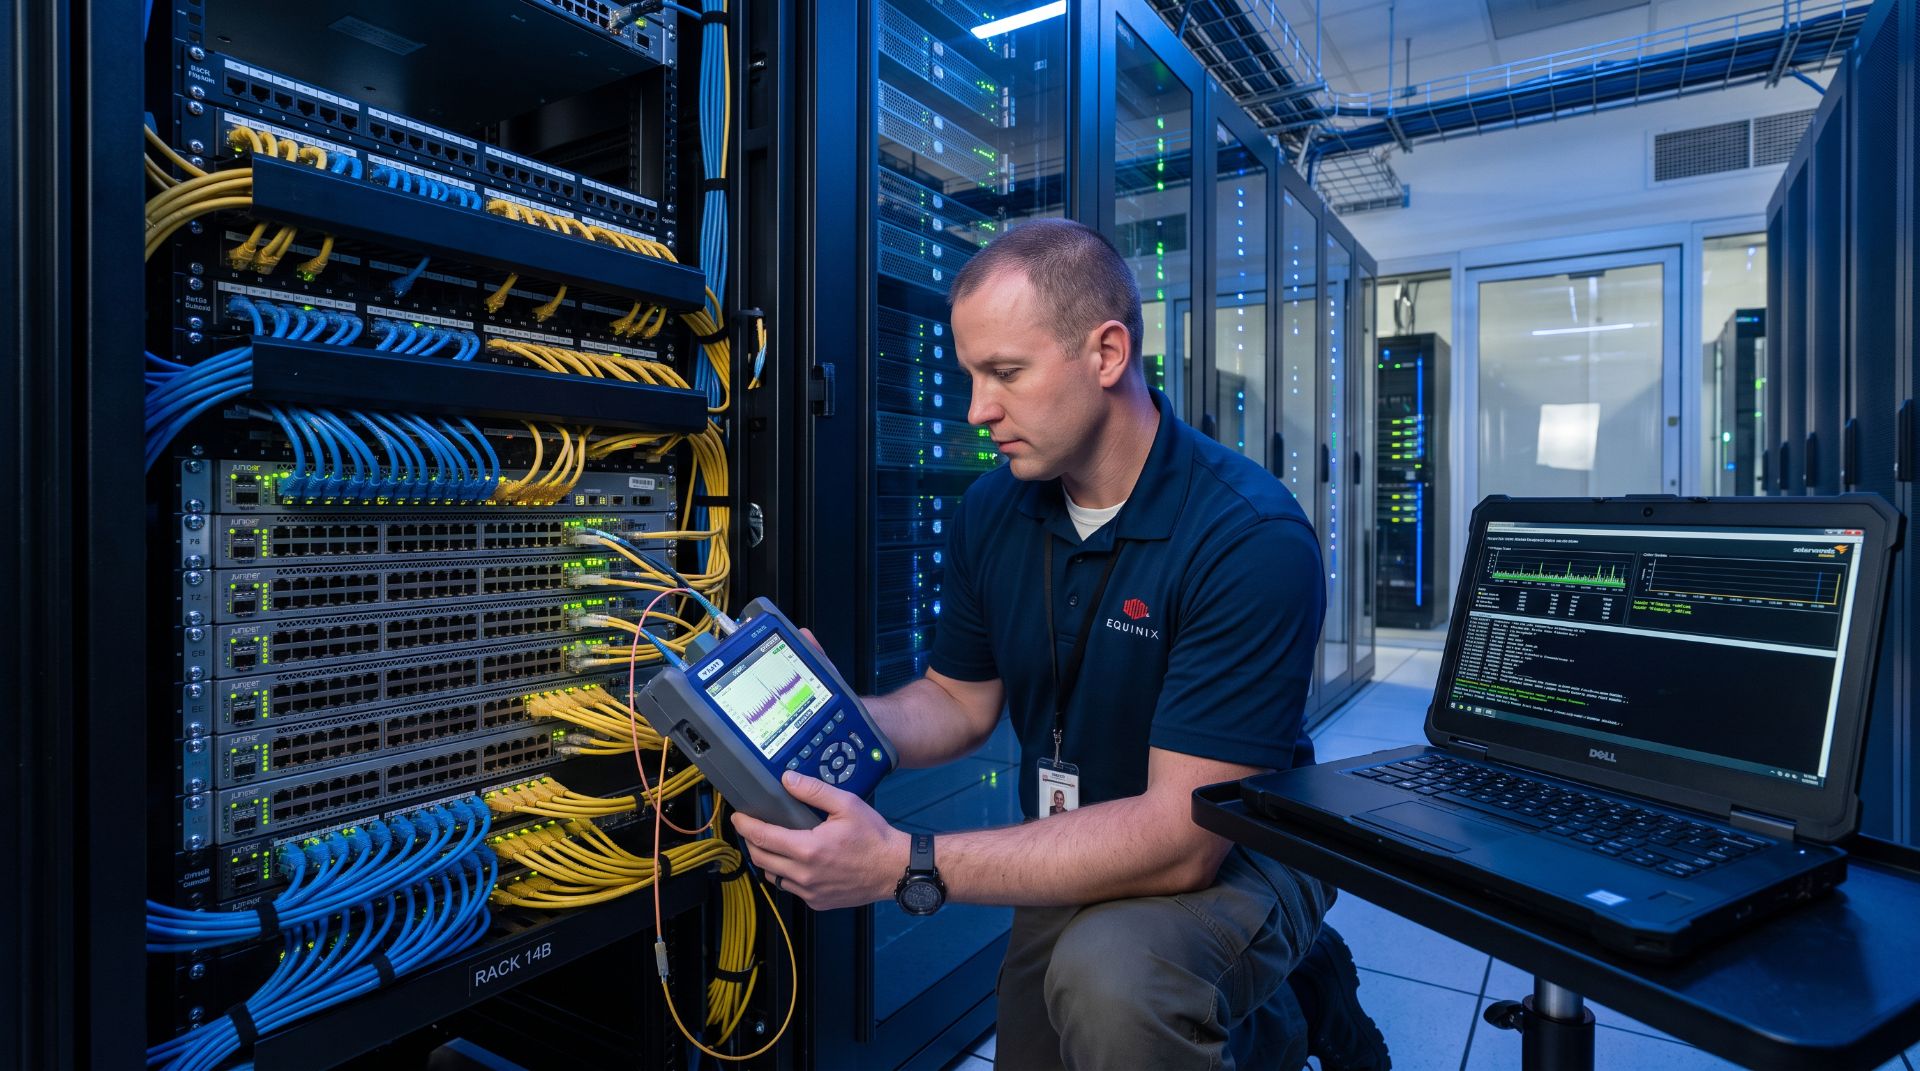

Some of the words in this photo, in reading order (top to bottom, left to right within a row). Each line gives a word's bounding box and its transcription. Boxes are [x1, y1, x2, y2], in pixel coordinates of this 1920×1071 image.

[1106, 618, 1159, 640] EQUINIX
[1589, 748, 1617, 763] DELL
[475, 954, 520, 987] RACK
[525, 942, 552, 965] 14B
